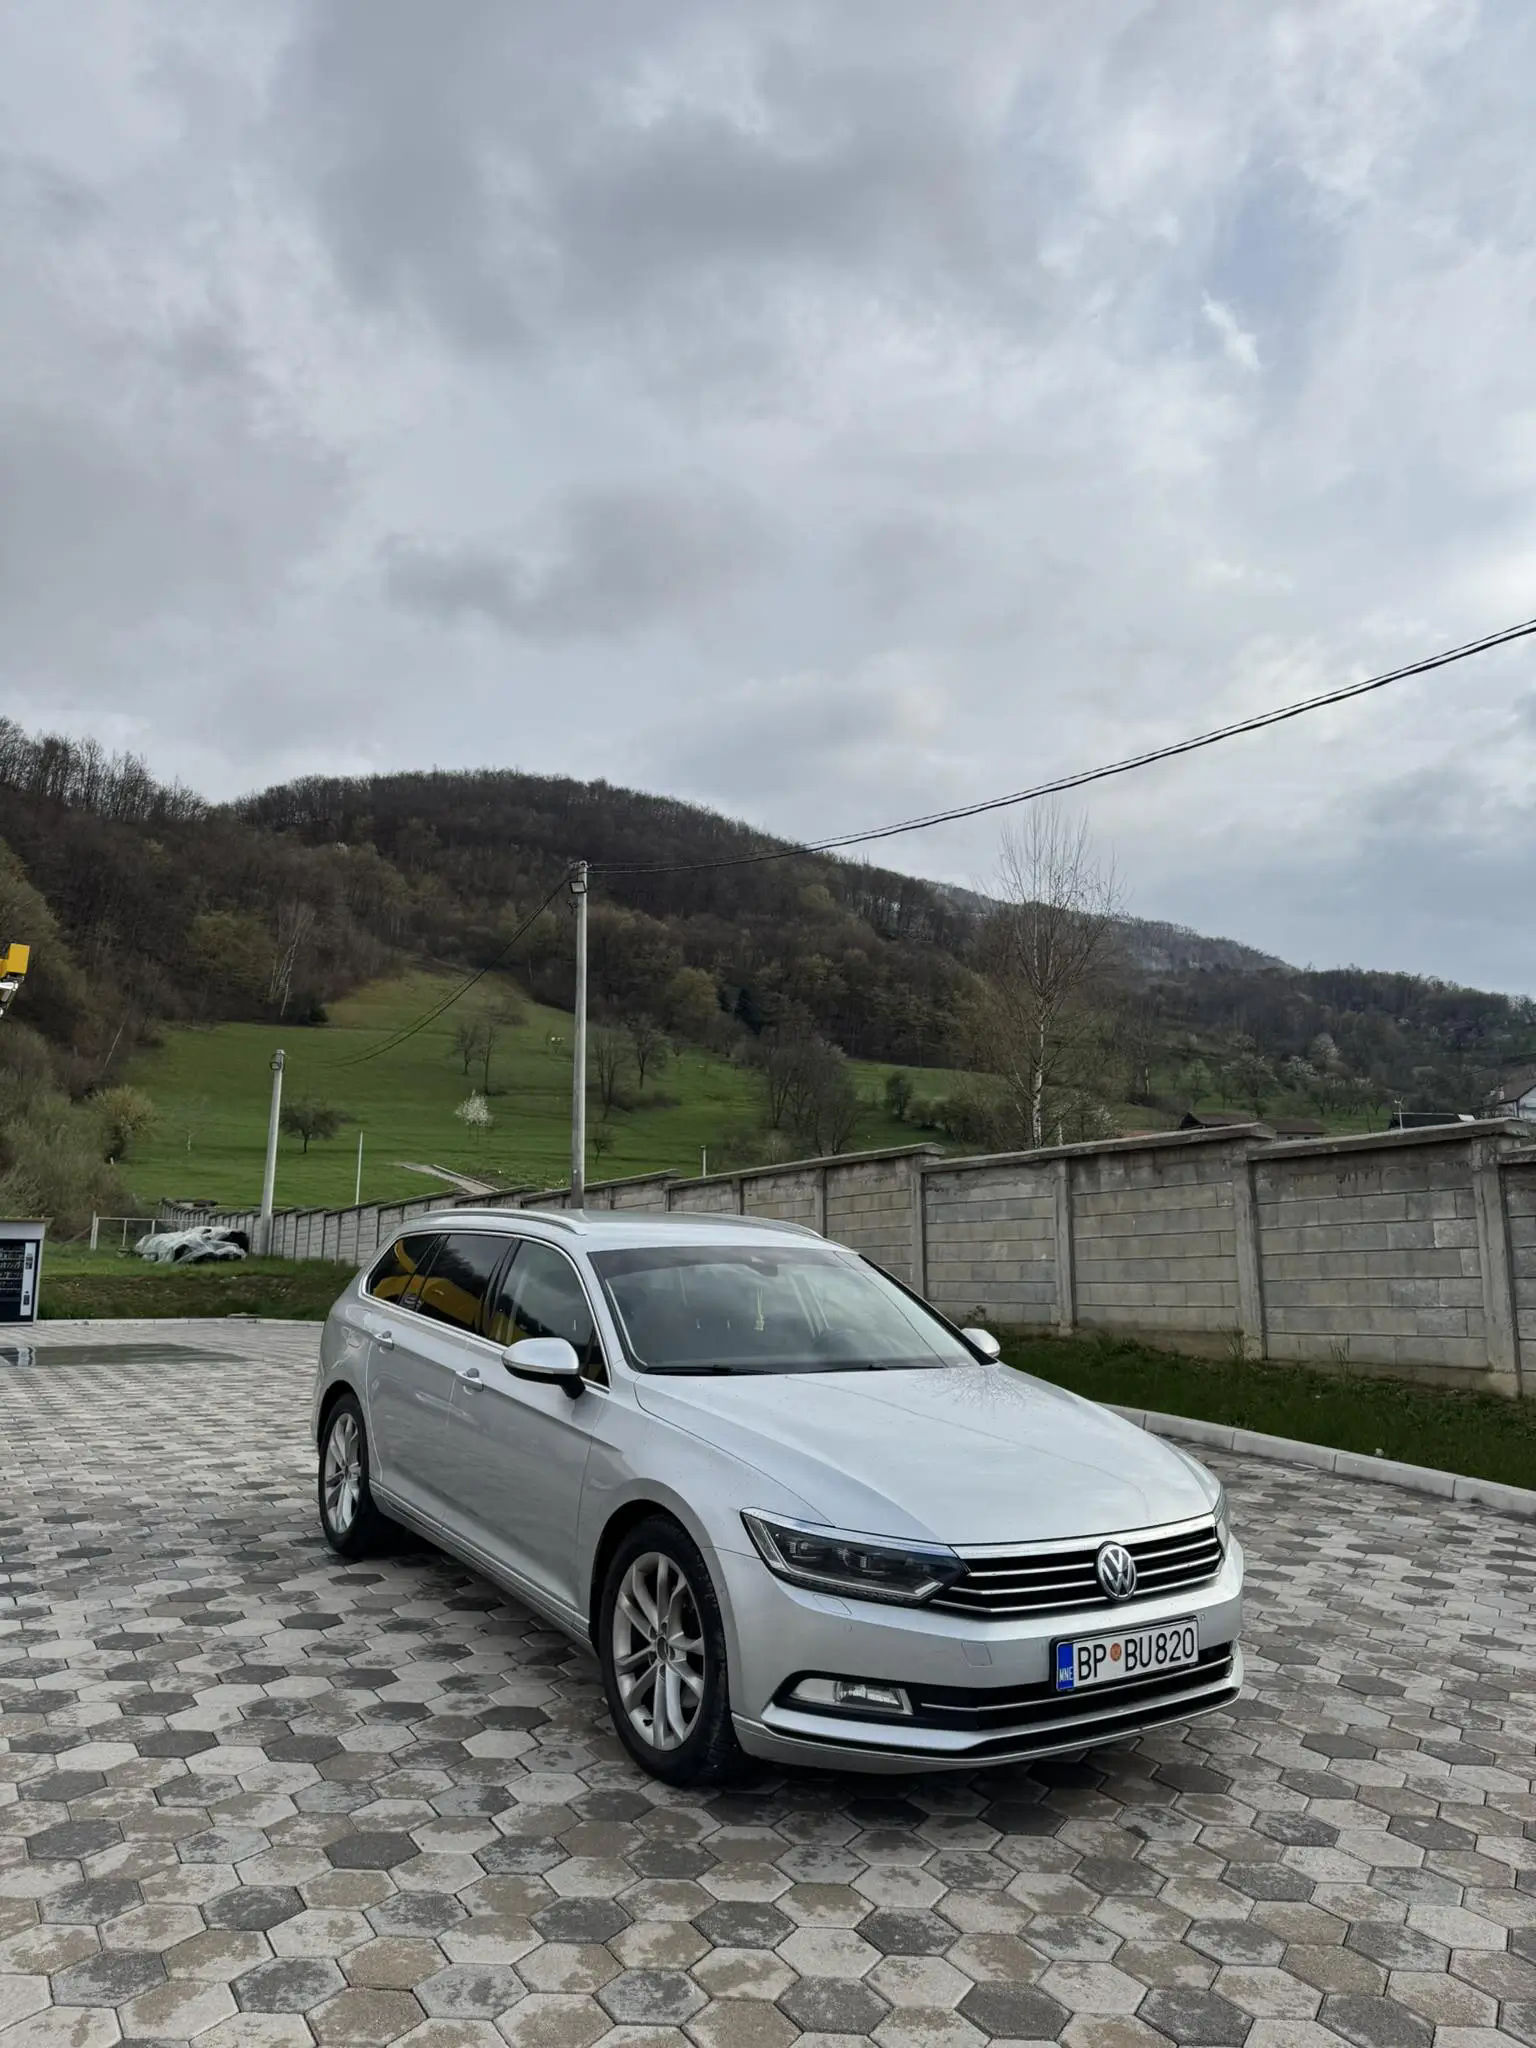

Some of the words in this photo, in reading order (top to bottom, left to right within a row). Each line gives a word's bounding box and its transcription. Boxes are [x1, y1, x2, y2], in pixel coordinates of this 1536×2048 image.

[1098, 1545, 1136, 1597] VW
[1058, 1666, 1074, 1682] MNE
[1077, 1644, 1107, 1681] BP
[1124, 1627, 1195, 1672] BU820
